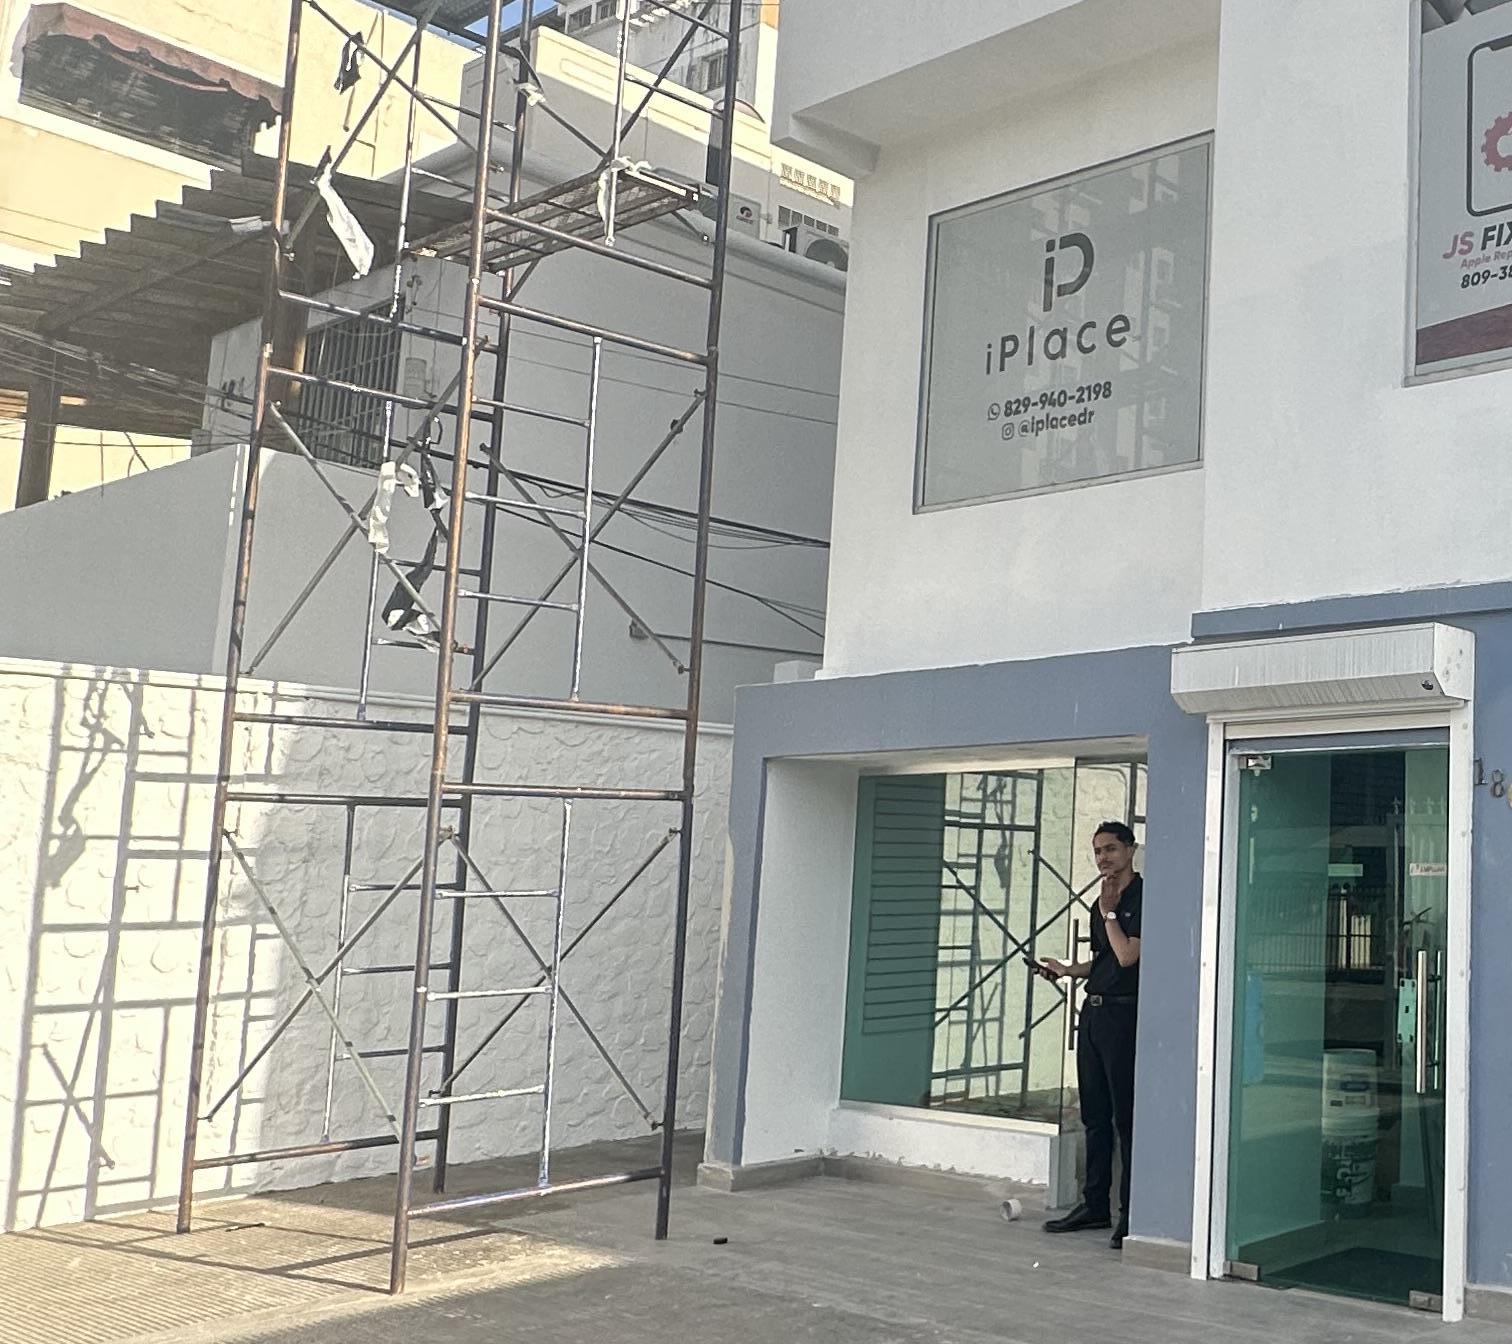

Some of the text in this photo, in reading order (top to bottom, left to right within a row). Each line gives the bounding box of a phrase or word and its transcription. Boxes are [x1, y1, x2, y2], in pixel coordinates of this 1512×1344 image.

[1443, 230, 1474, 260] JS
[1460, 253, 1491, 271] Apple
[985, 313, 1131, 375] iPlace
[1003, 381, 1112, 417] 829-940-2198
[1018, 407, 1095, 437] @iplacedr
